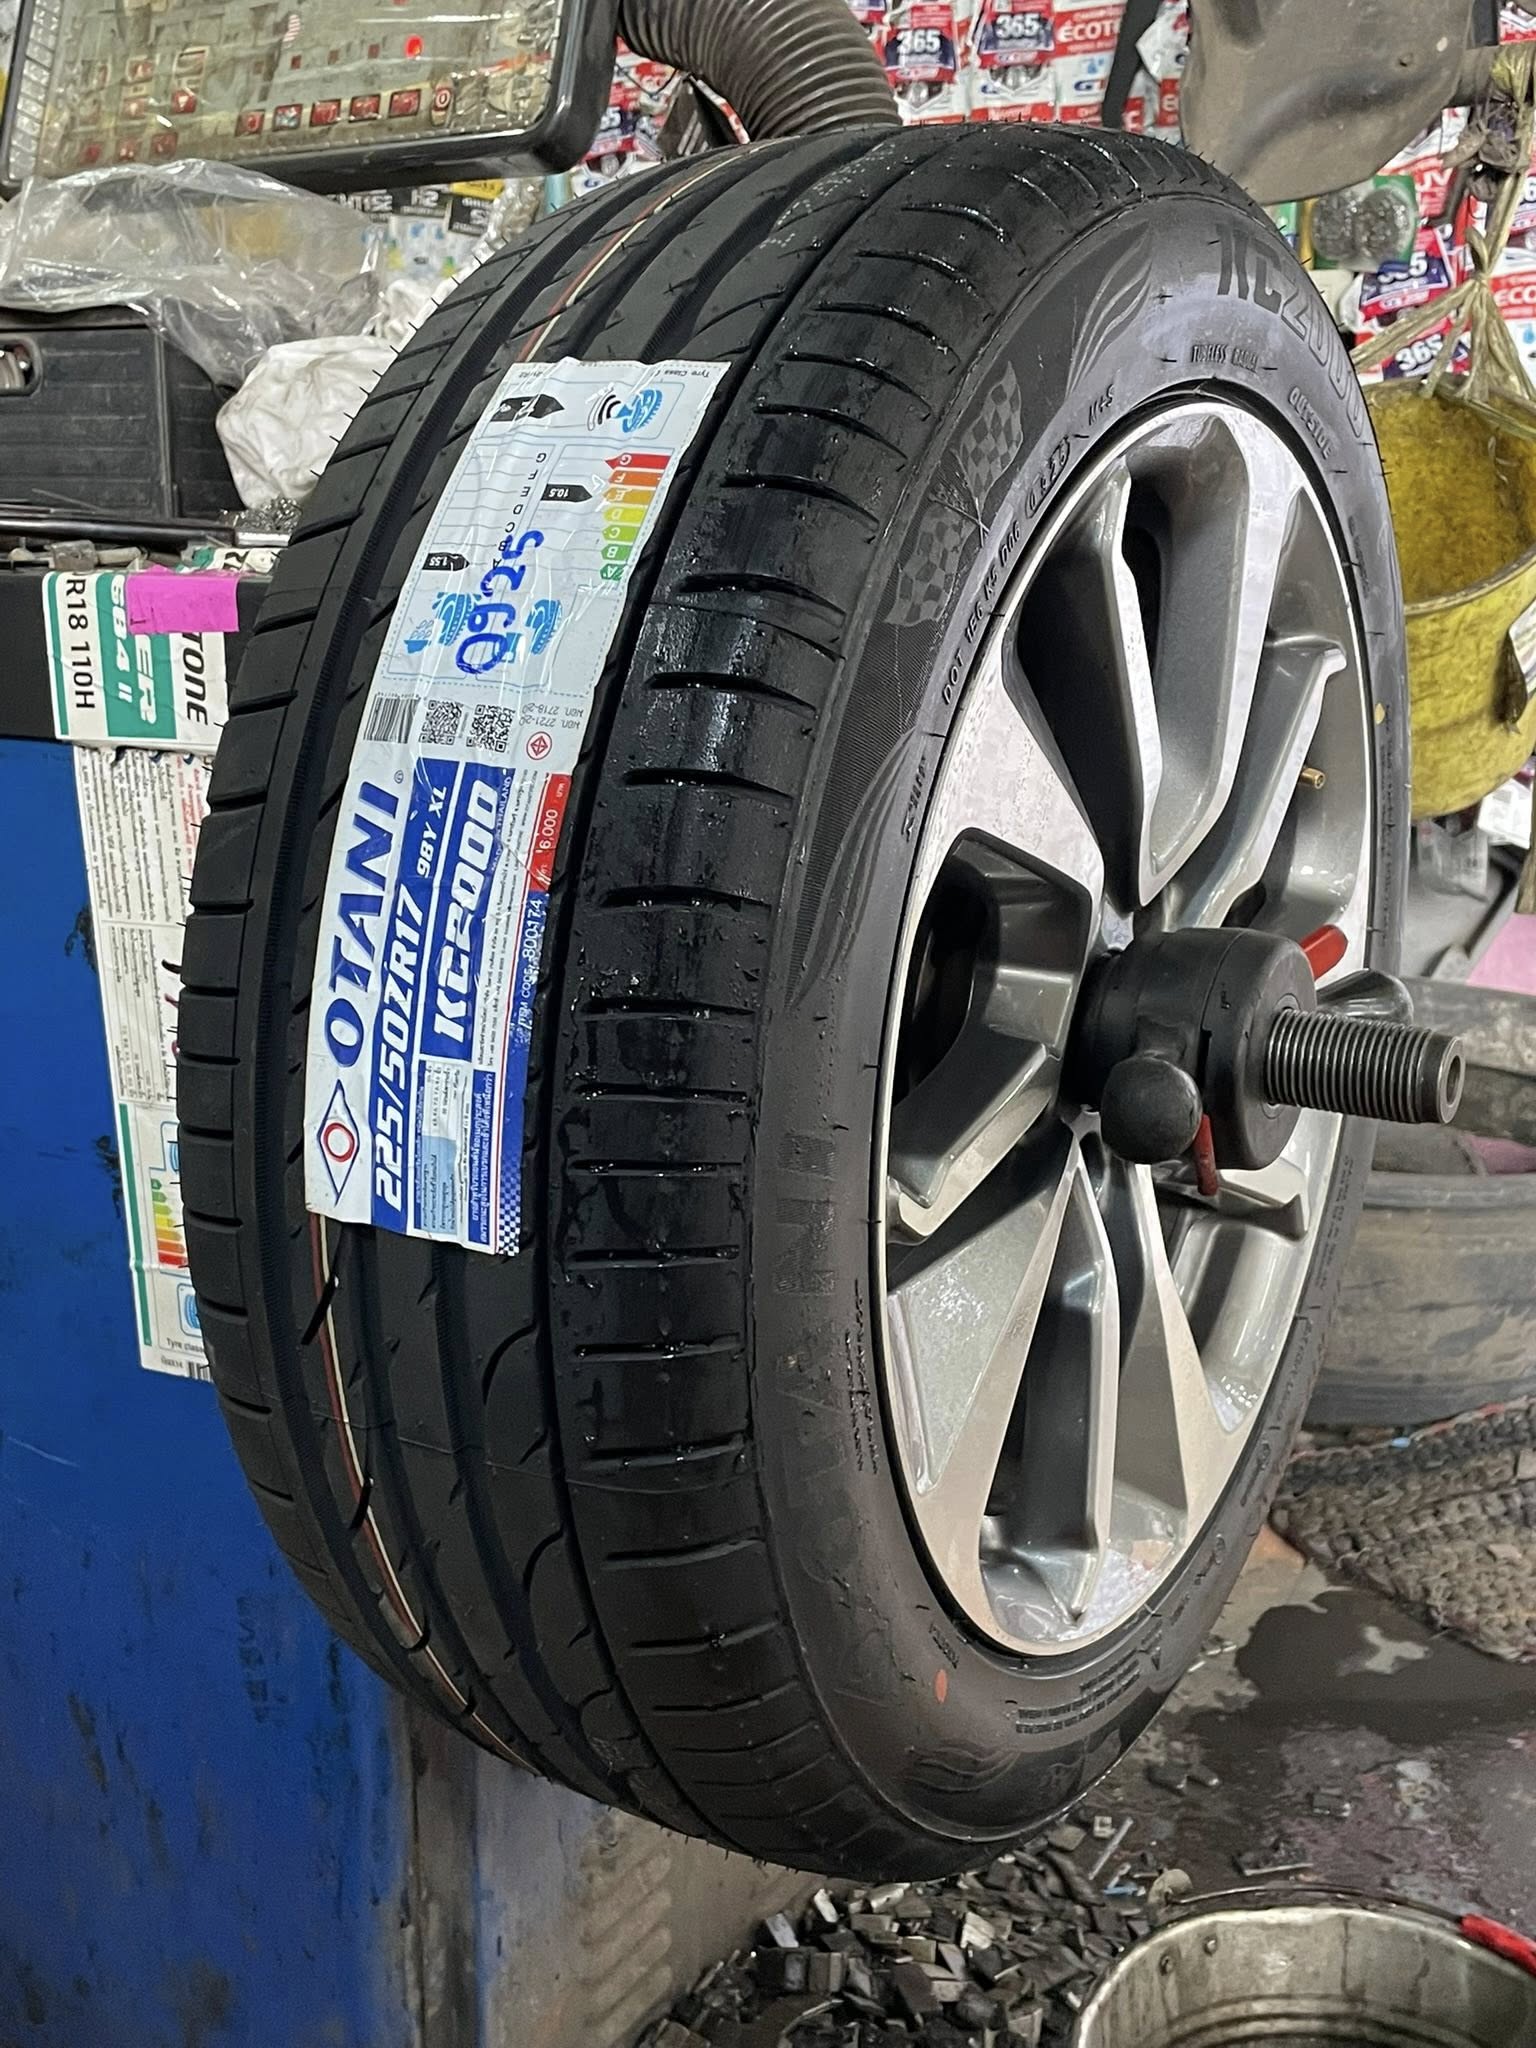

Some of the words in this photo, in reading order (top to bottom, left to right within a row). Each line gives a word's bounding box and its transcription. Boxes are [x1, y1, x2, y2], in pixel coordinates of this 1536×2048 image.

[896, 30, 941, 54] 365
[996, 14, 1041, 39] 365
[1395, 334, 1444, 372] 365
[548, 488, 569, 498] 10.5
[429, 556, 450, 567] 1.55
[66, 578, 89, 631] R18
[455, 529, 545, 675] 0925
[70, 641, 96, 709] 110H
[182, 632, 209, 725] TONE
[941, 648, 965, 706] DOT
[497, 776, 513, 830] THAILAND
[538, 809, 559, 850] 6,000
[324, 781, 399, 1068] OTANI
[434, 780, 499, 1042] KC2000
[522, 898, 543, 959] 800174
[376, 884, 424, 1211] 225/50ZR17
[416, 822, 438, 879] 98Y
[432, 786, 448, 817] XL
